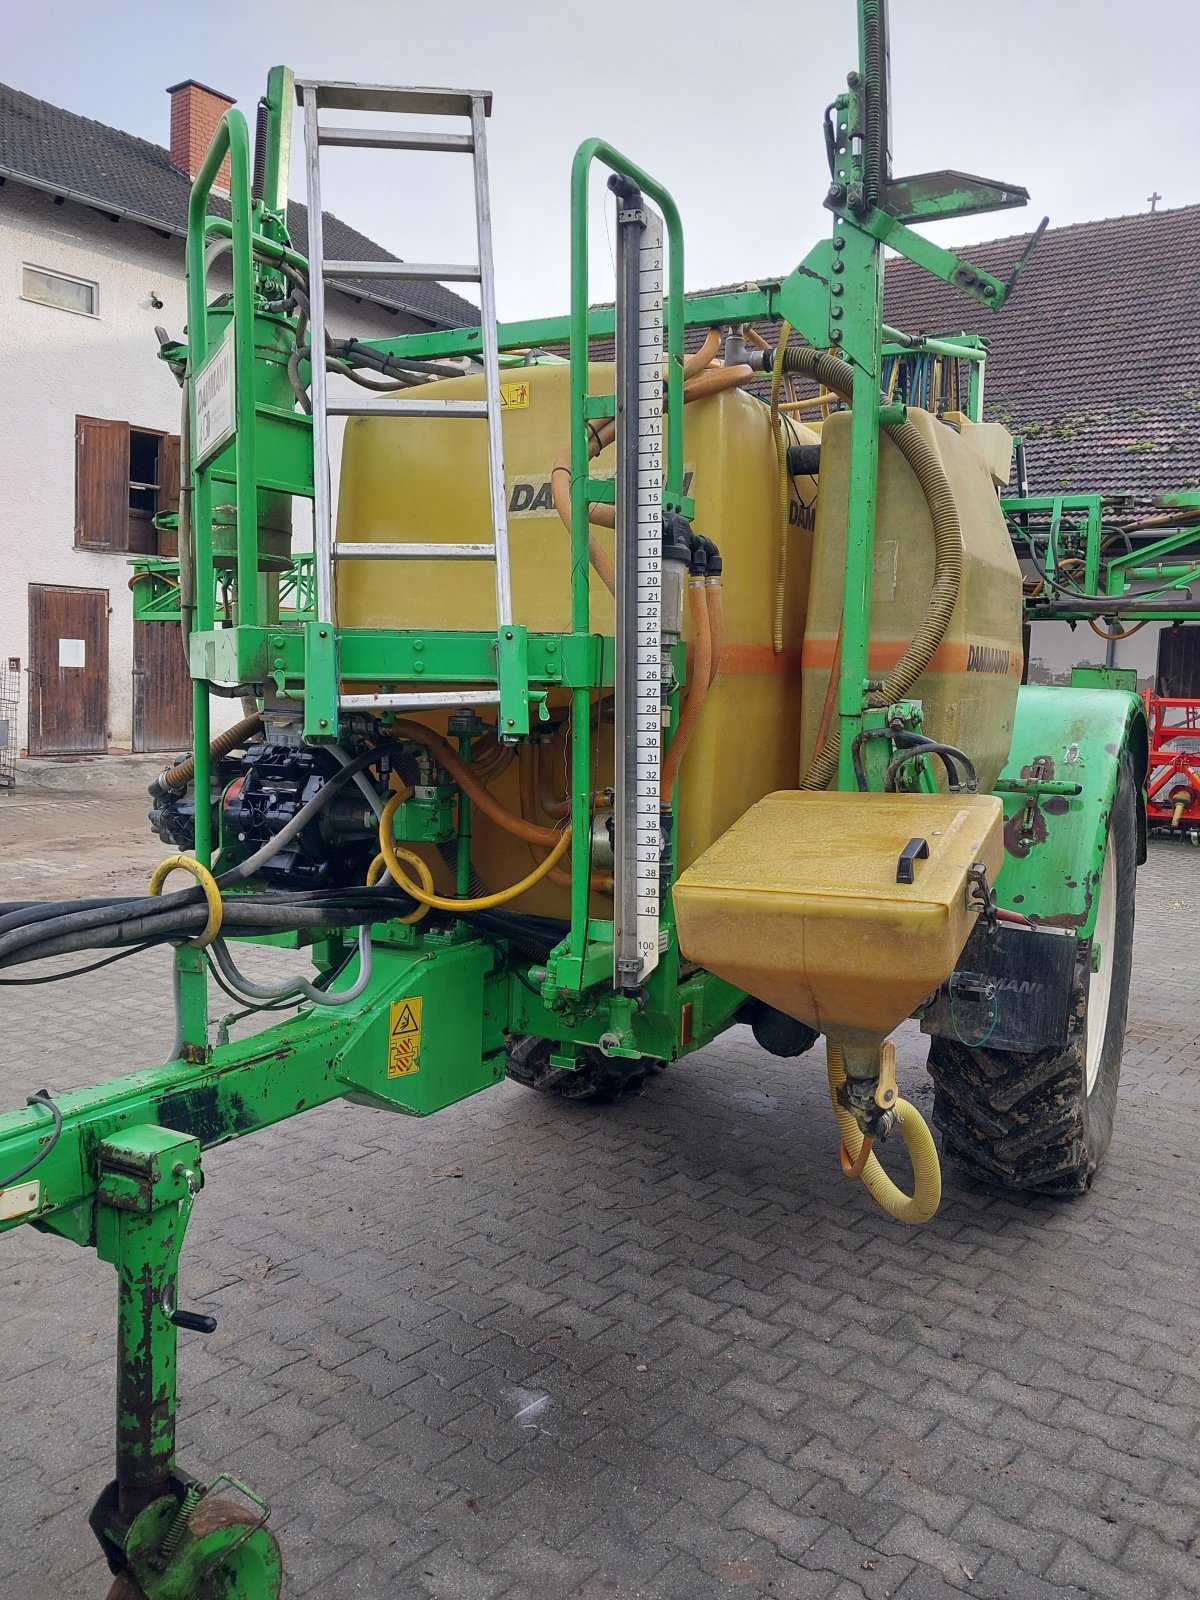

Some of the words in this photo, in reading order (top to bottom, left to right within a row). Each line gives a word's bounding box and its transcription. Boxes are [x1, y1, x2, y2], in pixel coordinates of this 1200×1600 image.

[654, 282, 660, 290] 3
[653, 318, 660, 326] 5
[653, 335, 660, 343] 6
[653, 371, 660, 379] 8
[653, 389, 660, 397] 9
[650, 424, 660, 433] 11
[649, 443, 659, 451] 12
[649, 460, 659, 468] 13
[649, 478, 659, 486] 14
[648, 494, 659, 502] 15
[648, 513, 659, 521] 16
[648, 530, 658, 538] 17
[648, 547, 658, 555] 18
[648, 562, 658, 570] 19
[647, 577, 658, 585] 20
[646, 622, 657, 630] 23
[646, 637, 657, 645] 24
[966, 644, 1010, 675] DAMMANN
[646, 671, 657, 679] 26
[646, 738, 657, 746] 30
[647, 754, 657, 762] 31
[646, 771, 657, 779] 32
[646, 787, 657, 795] 33
[646, 804, 656, 812] 34
[646, 820, 657, 828] 35
[646, 836, 657, 844] 36
[645, 852, 656, 860] 37
[645, 888, 656, 896] 39
[645, 906, 656, 914] 40
[638, 941, 654, 950] 100
